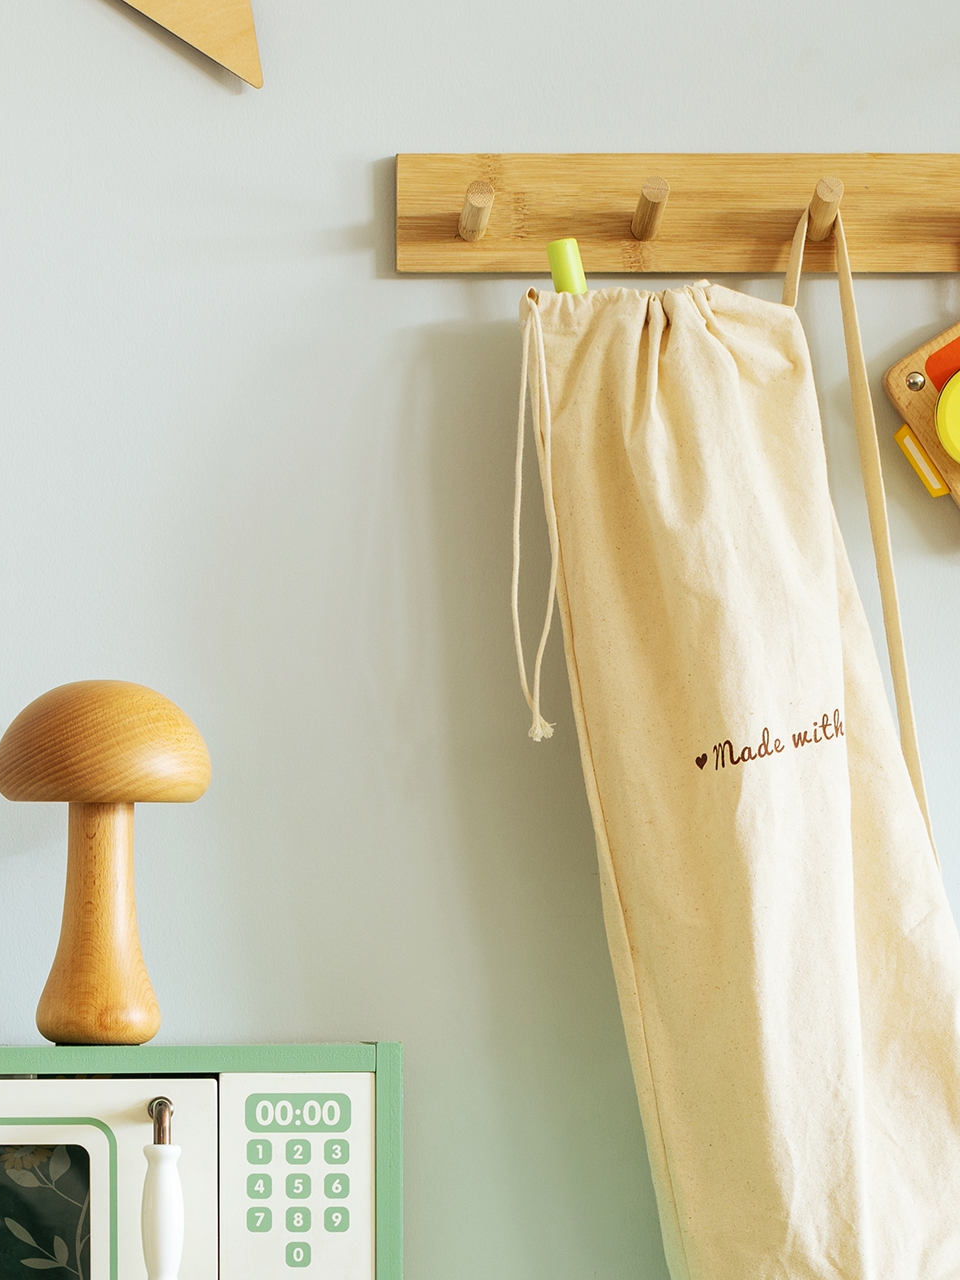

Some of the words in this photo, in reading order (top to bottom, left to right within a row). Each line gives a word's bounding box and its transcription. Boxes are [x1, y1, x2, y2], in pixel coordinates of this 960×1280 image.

[712, 727, 785, 770] Made
[791, 708, 845, 749] with
[255, 1100, 341, 1126] 00:00
[256, 1144, 263, 1159] 1
[293, 1144, 304, 1159] 2
[332, 1144, 342, 1159] 3
[254, 1179, 265, 1193] 4
[293, 1179, 304, 1193] 5
[332, 1179, 342, 1193] 6
[255, 1213, 265, 1227] 7
[293, 1213, 304, 1227] 8
[332, 1213, 342, 1227] 9
[293, 1248, 304, 1262] 0
